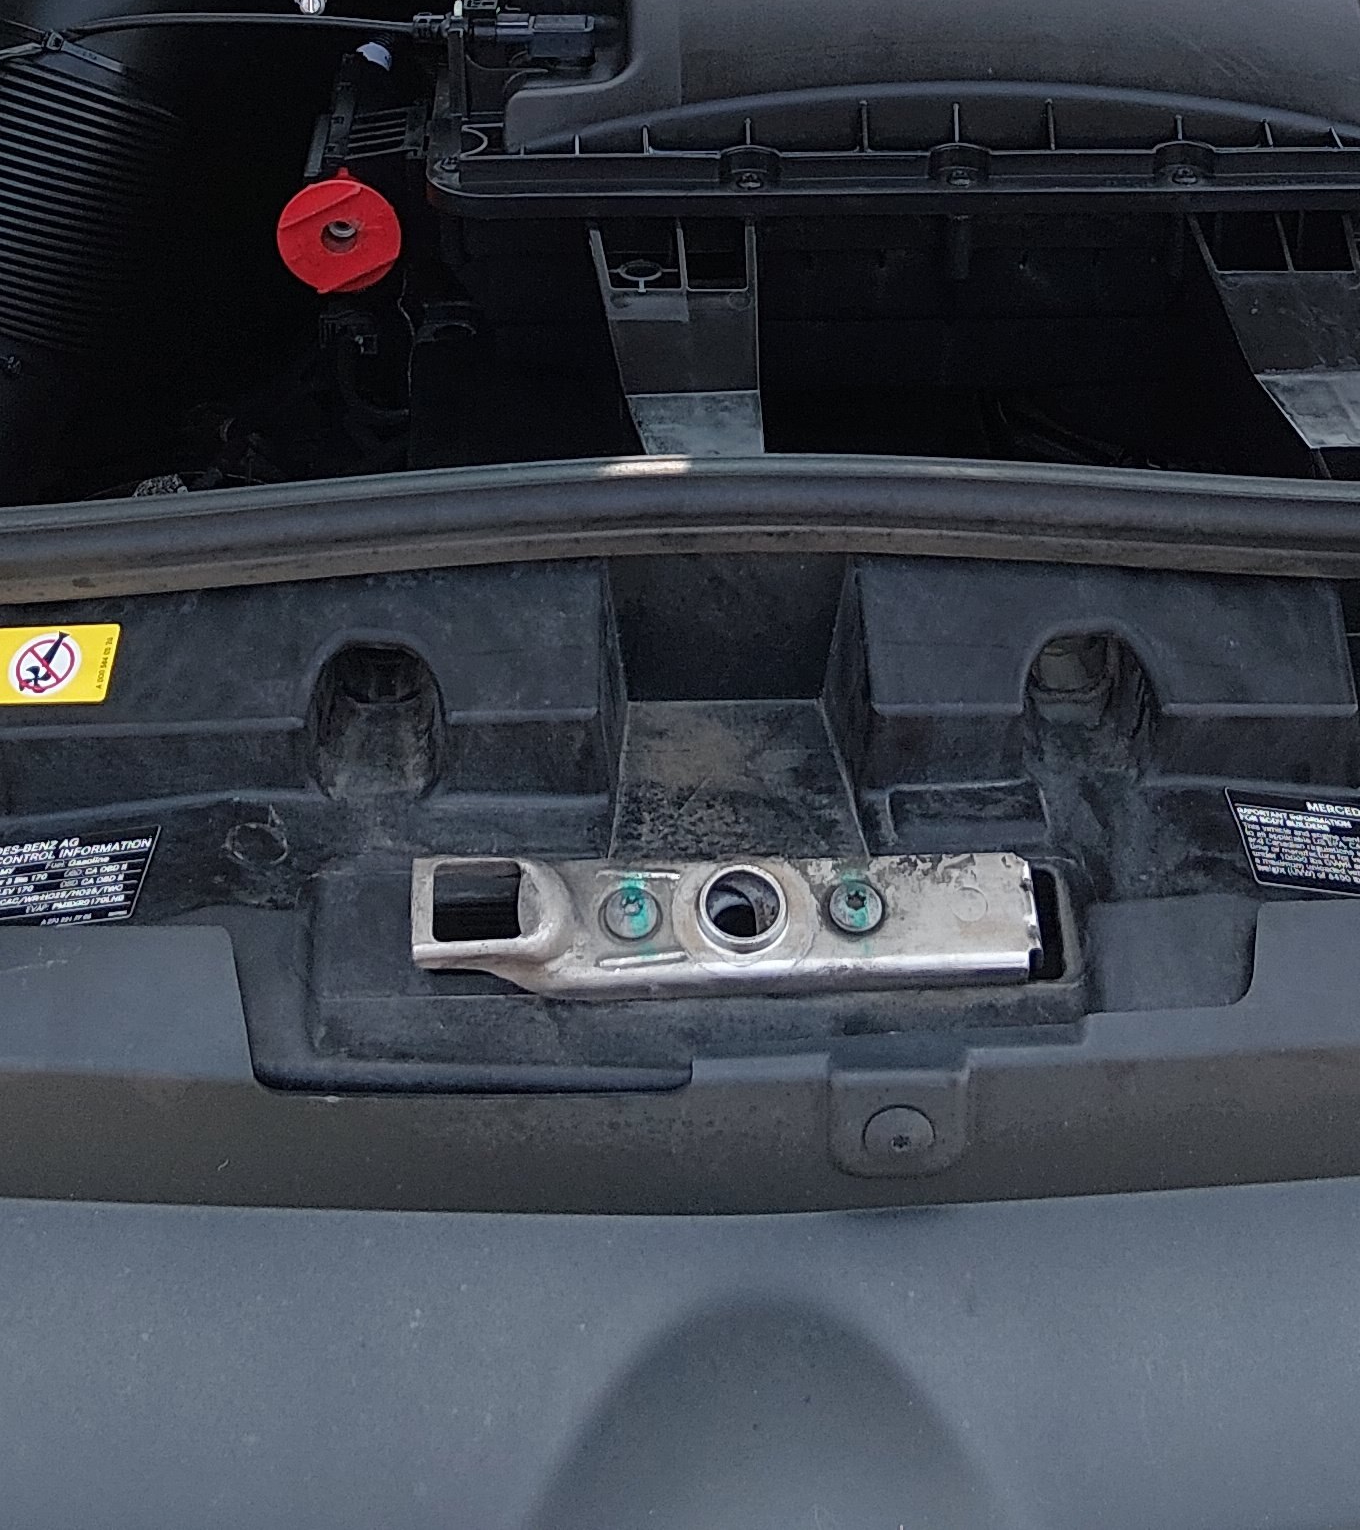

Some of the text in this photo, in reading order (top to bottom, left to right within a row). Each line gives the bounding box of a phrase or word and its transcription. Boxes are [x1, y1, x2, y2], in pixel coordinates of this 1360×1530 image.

[1237, 807, 1352, 828] IMPORTANT INFORMATION
[59, 838, 79, 849] AG
[59, 838, 152, 858] INFORMATION
[68, 856, 110, 867] Gasoline
[85, 867, 98, 875] CA
[31, 873, 48, 881] 170
[81, 878, 94, 886] CA
[17, 885, 34, 894] 170
